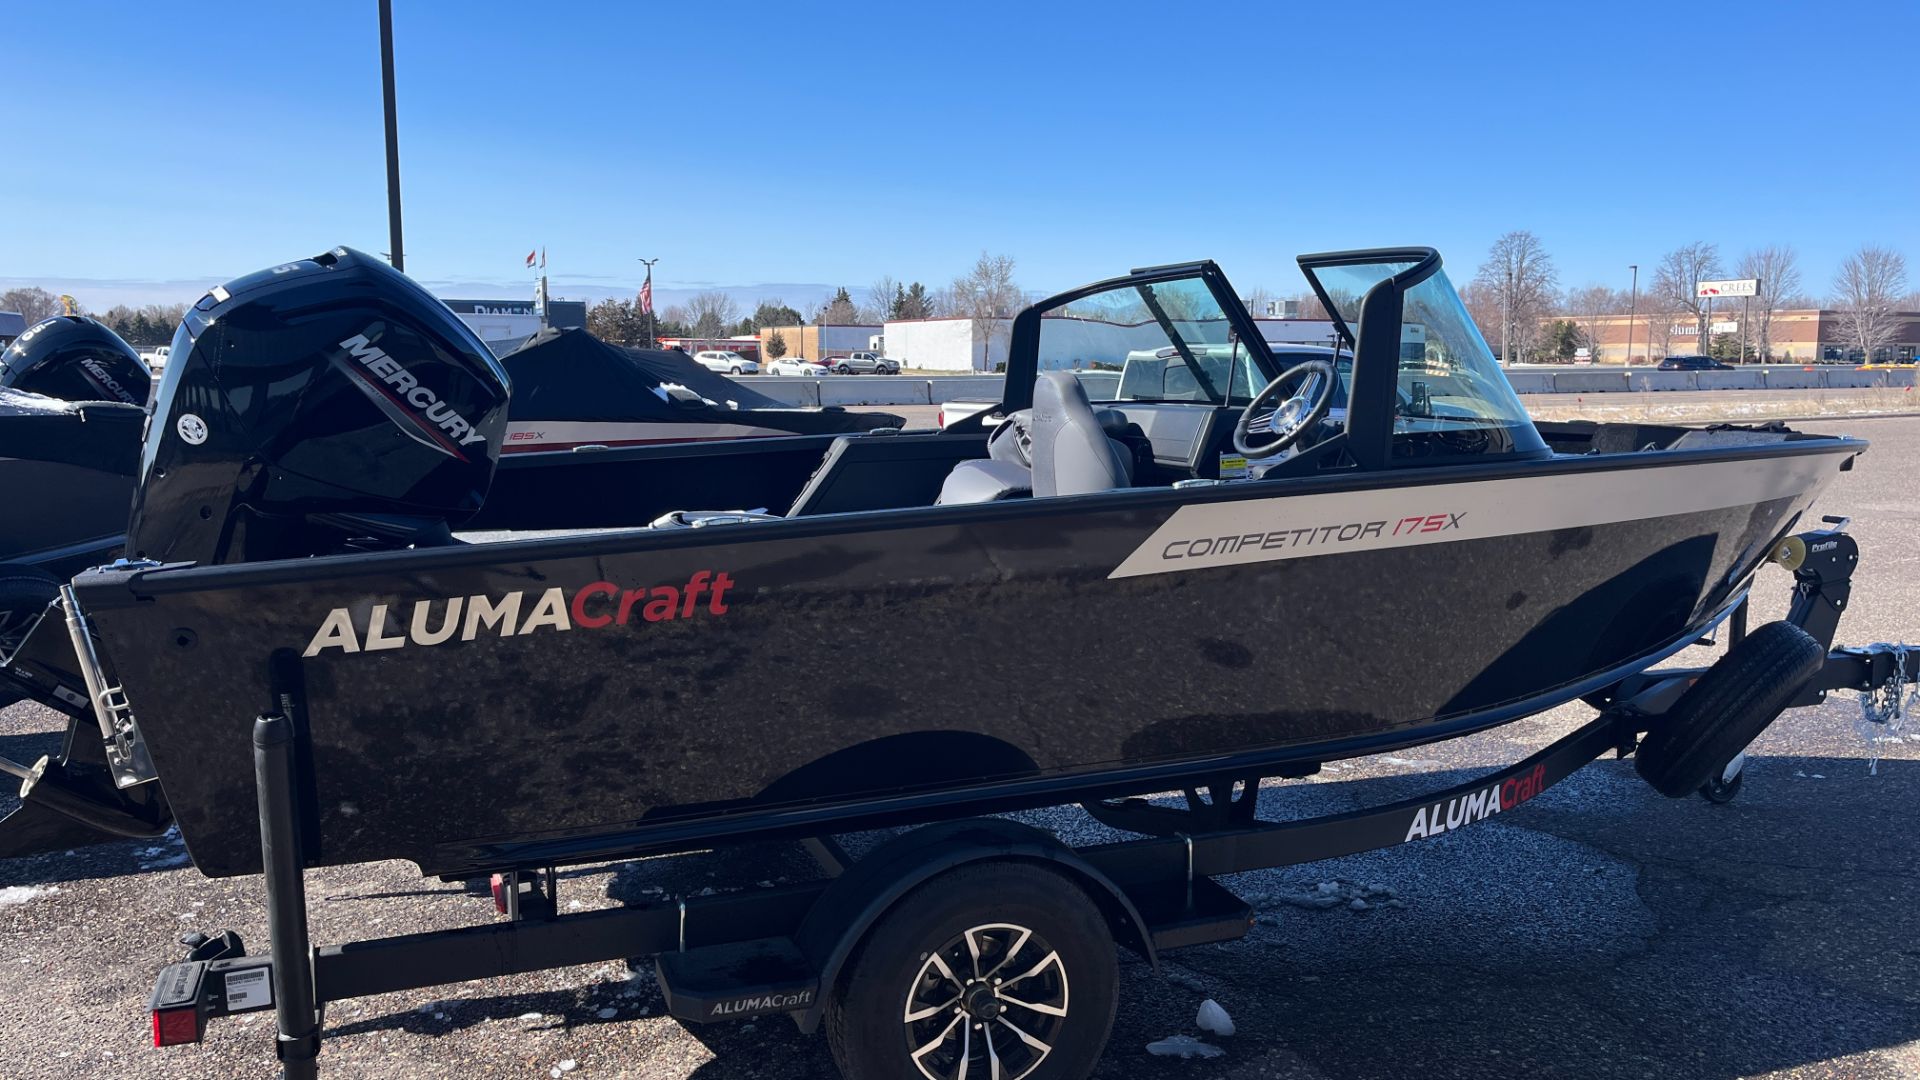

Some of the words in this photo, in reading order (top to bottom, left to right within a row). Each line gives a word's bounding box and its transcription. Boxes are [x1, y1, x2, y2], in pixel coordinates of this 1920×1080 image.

[474, 305, 533, 315] DIAMN
[1720, 282, 1754, 292] CREES
[80, 358, 138, 404] MERCURY
[338, 333, 487, 446] MERCURY
[1162, 520, 1388, 560] COMPETITOR
[1391, 511, 1468, 536] 175X
[301, 570, 735, 658] ALUMACraft
[1404, 763, 1547, 843] ALUMACraft
[710, 990, 811, 1015] ALUMACraft
